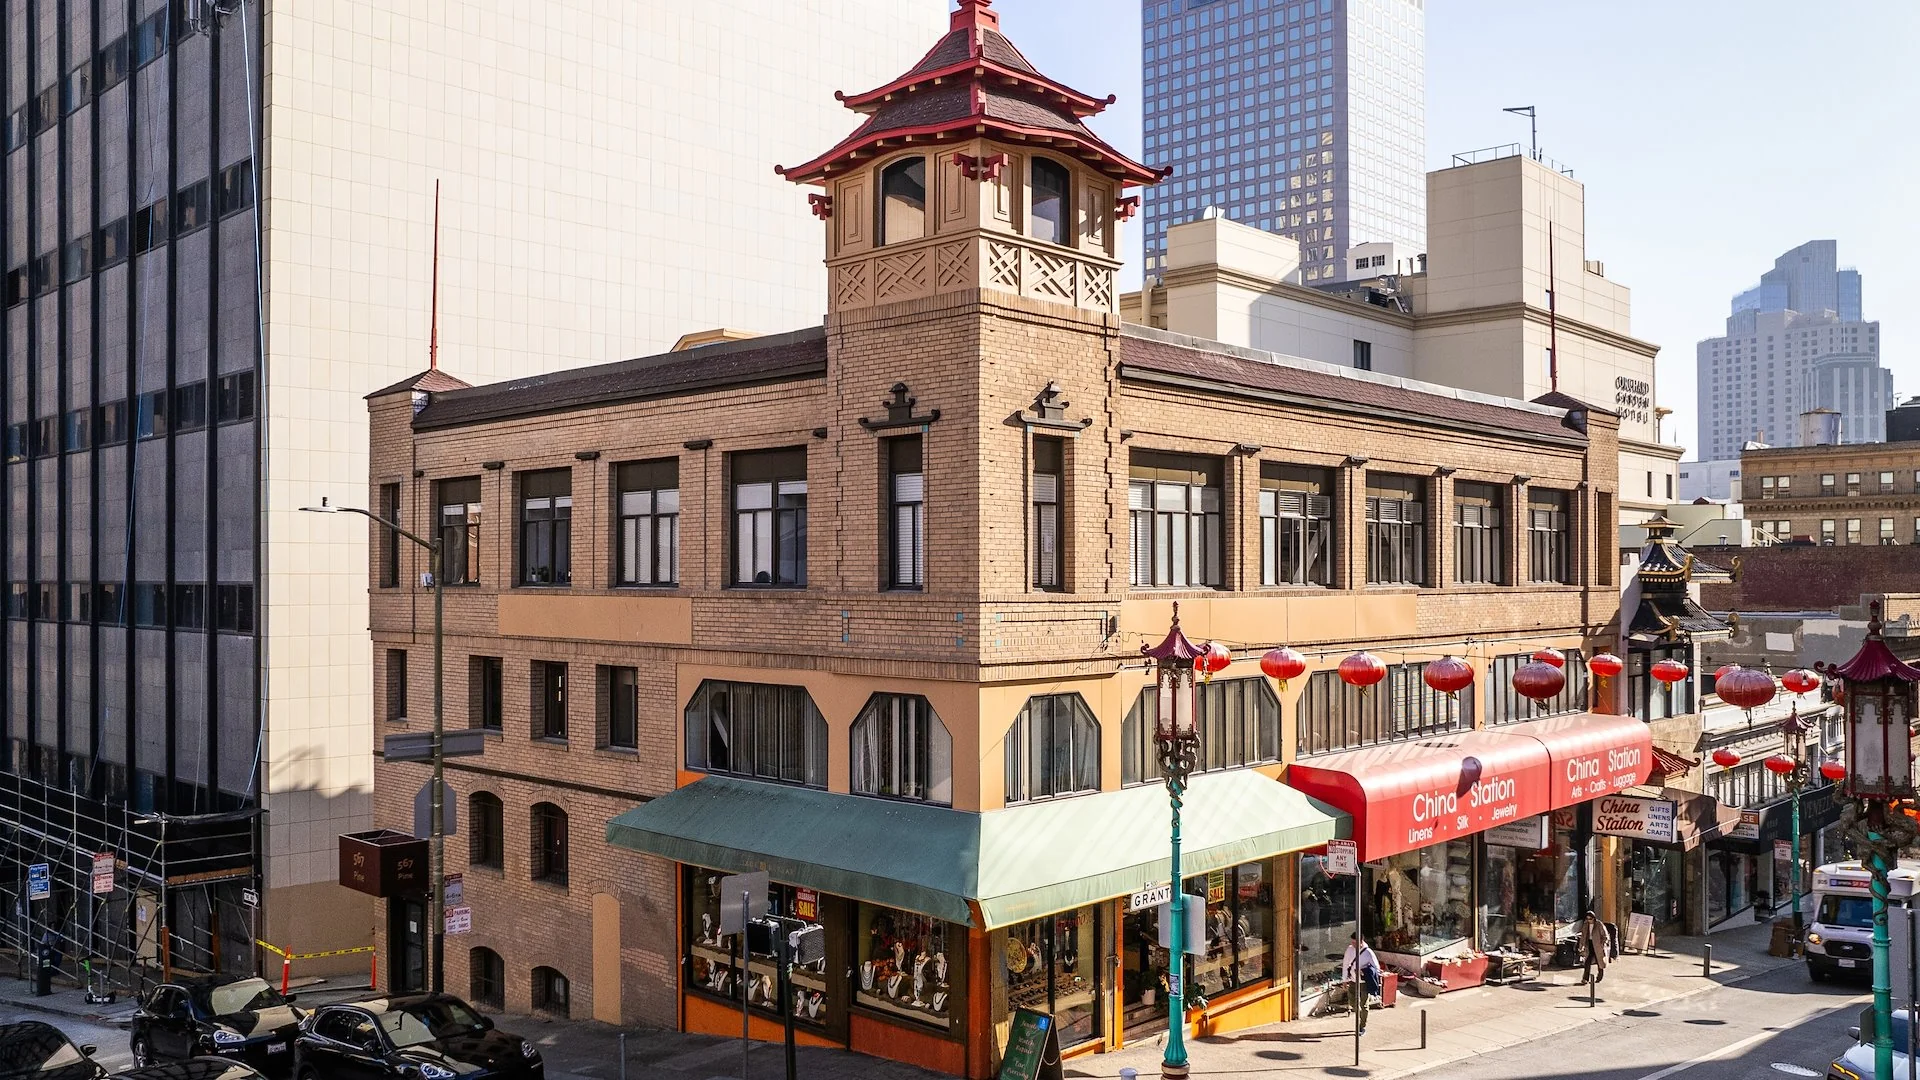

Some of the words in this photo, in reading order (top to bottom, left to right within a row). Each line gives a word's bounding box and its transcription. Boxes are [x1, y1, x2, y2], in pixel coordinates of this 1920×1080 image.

[1567, 757, 1600, 783] China
[1608, 747, 1640, 772] Station
[1571, 785, 1582, 799] Arts
[1590, 779, 1607, 793] Crafts
[1613, 772, 1636, 788] Luggage
[1413, 791, 1457, 822] China
[1470, 776, 1515, 808] Station
[1601, 799, 1640, 814] China
[1408, 826, 1433, 844] Linens
[1457, 815, 1469, 830] Silk
[1491, 803, 1517, 820] Jewelry
[1596, 815, 1644, 831] Station
[1647, 813, 1671, 821] LINENS
[353, 852, 364, 868] 567
[397, 858, 413, 871] 567
[1134, 887, 1170, 907] GRANT
[1209, 886, 1224, 901] SALE
[798, 900, 815, 918] SALE
